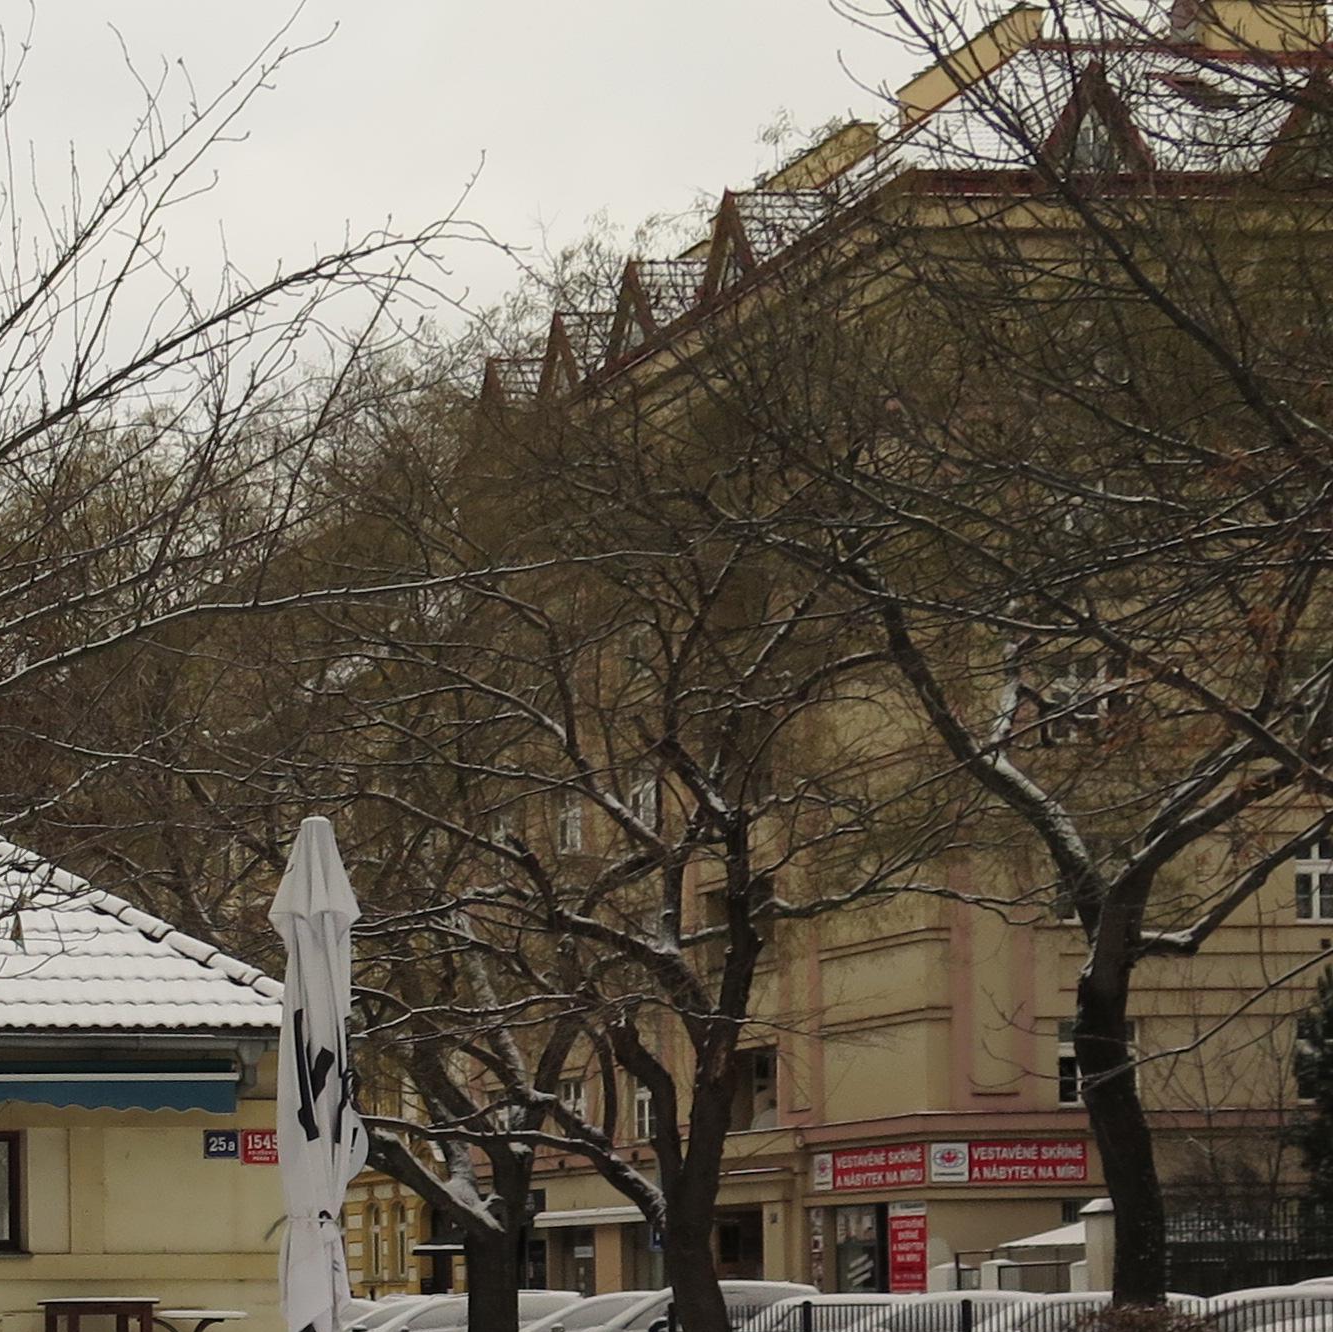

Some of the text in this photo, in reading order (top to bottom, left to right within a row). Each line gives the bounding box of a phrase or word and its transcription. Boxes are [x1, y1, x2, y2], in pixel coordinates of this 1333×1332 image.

[247, 1134, 278, 1149] 1545
[835, 1175, 843, 1187] A
[844, 1172, 884, 1186] NÁBYTEK
[885, 1170, 898, 1182] NA
[899, 1167, 923, 1182] MÍRU
[971, 1166, 981, 1179] A
[983, 1163, 1036, 1179] NÁBYTEK
[1037, 1166, 1054, 1179] NA
[1056, 1164, 1085, 1178] MÍRU
